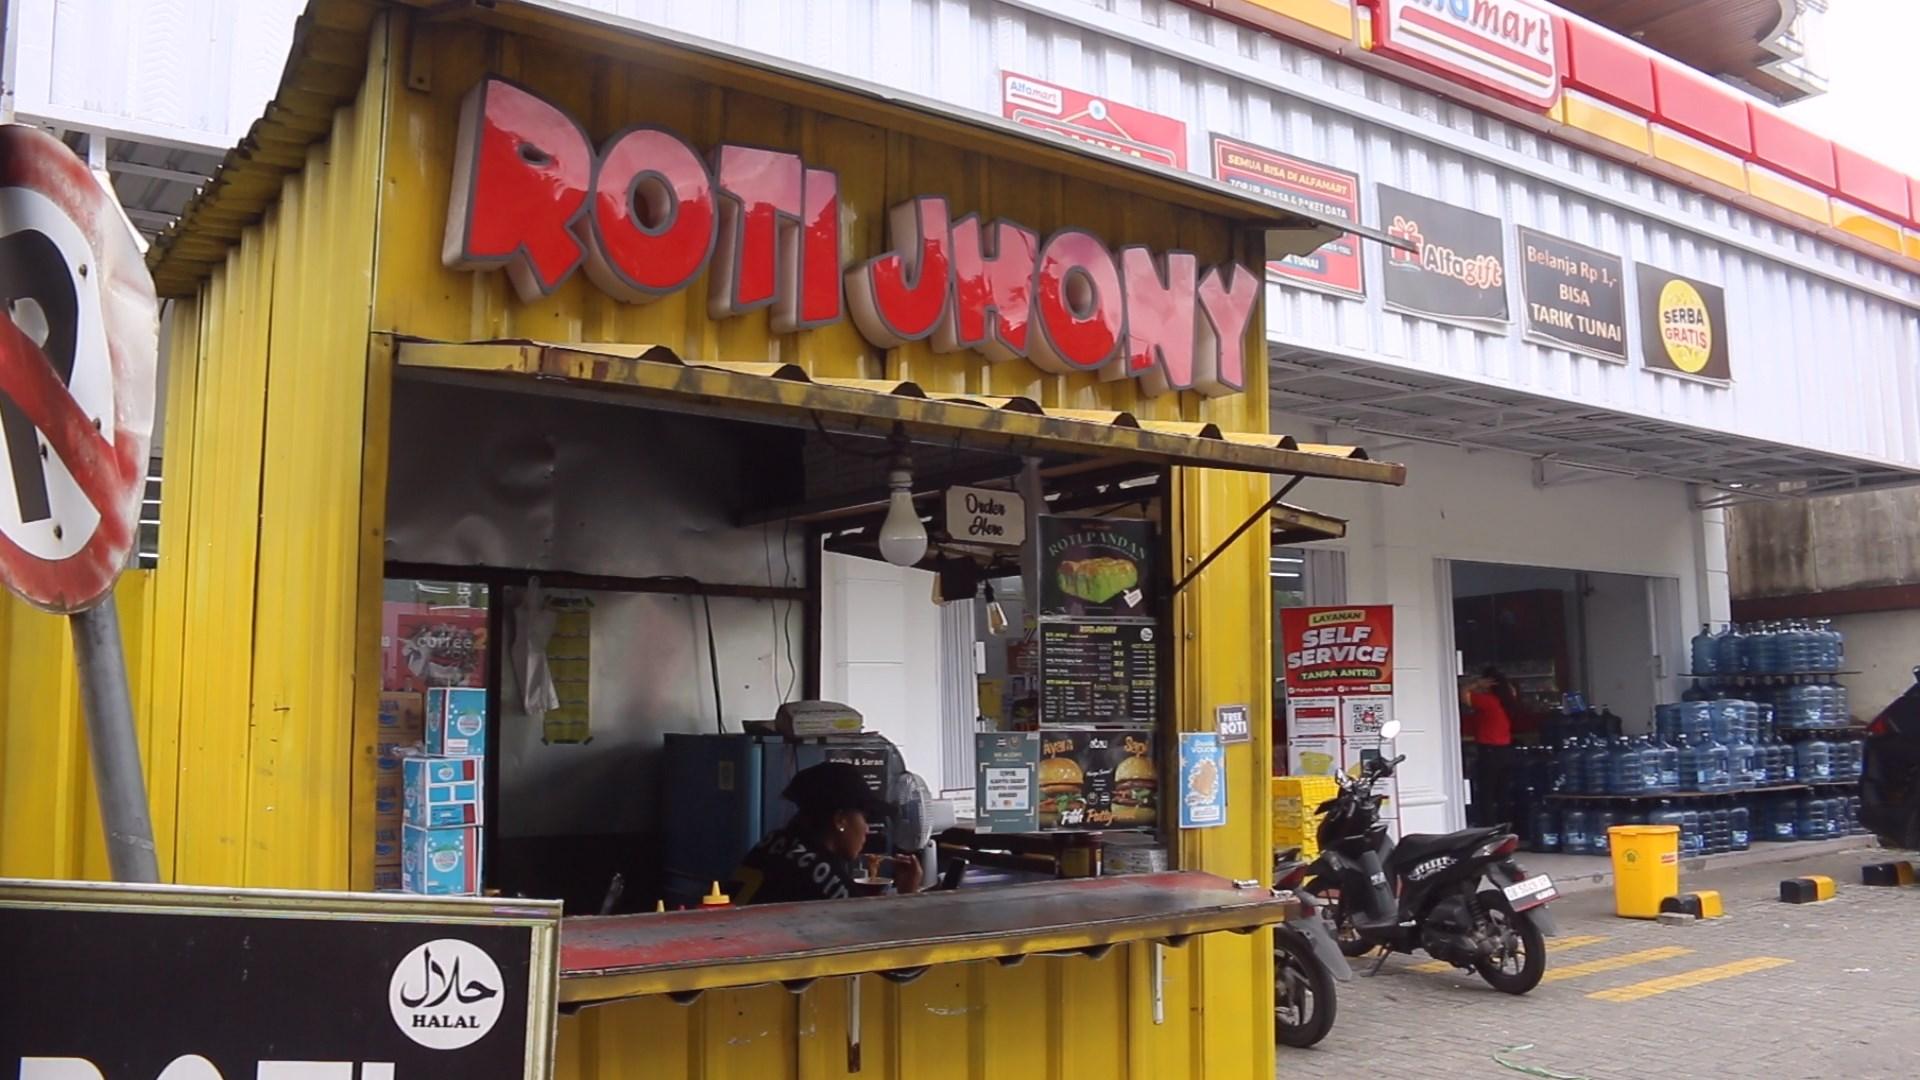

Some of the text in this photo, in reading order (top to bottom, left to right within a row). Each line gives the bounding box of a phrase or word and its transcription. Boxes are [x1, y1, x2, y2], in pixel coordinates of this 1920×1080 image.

[1416, 0, 1550, 55] amart
[1010, 81, 1057, 102] Alfamart
[1228, 154, 1347, 195] SEMUA BISA DI ALFAMART
[1325, 205, 1347, 218] DATA
[442, 77, 1259, 398] ROTI JHONY
[1424, 244, 1502, 289] Alfagift
[1527, 245, 1617, 288] Belanja Rp 1,-
[1559, 284, 1590, 306] BISA
[1531, 303, 1621, 342] TARIK TUNAI
[1664, 308, 1704, 326] SERBA
[1665, 329, 1707, 349] GRATIS
[966, 493, 1005, 516] Order
[969, 515, 1003, 536] Here
[1048, 532, 1082, 557] ROTI
[1312, 612, 1362, 624] LAYANAN
[416, 634, 472, 649] coffee
[1302, 626, 1371, 648] SELF
[1287, 646, 1388, 669] SERVICE
[1302, 669, 1338, 680] TANPA
[1222, 712, 1243, 721] FREE
[1221, 721, 1247, 735] ROTI
[854, 758, 860, 766] &
[862, 758, 884, 766] Saran
[400, 946, 498, 1008] حلال
[411, 1014, 480, 1028] HALAL
